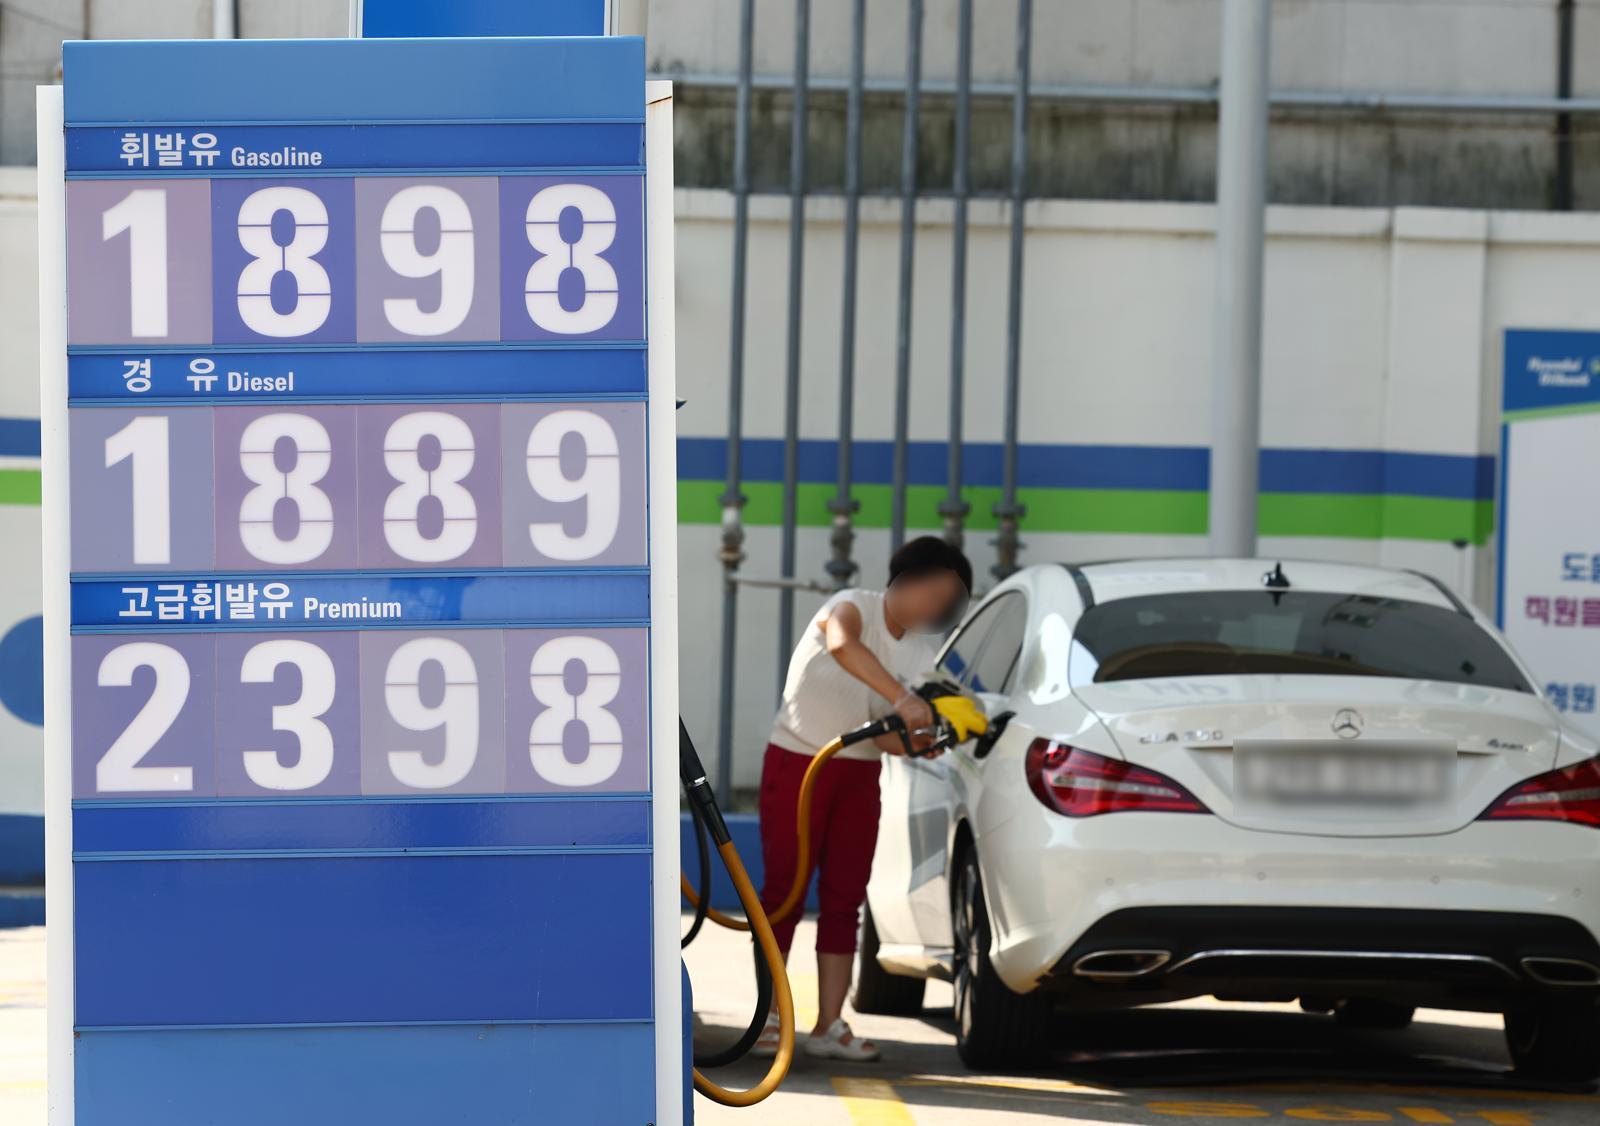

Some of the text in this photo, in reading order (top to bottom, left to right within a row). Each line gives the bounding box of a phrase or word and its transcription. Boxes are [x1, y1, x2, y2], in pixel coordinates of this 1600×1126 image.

[119, 132, 323, 167] 휘발유 Gasoline
[102, 183, 619, 338] 1898
[227, 371, 294, 392] Diesel
[104, 409, 622, 565] 1889
[118, 582, 402, 620] 고급휘발유 Premium
[95, 635, 624, 793] 2398
